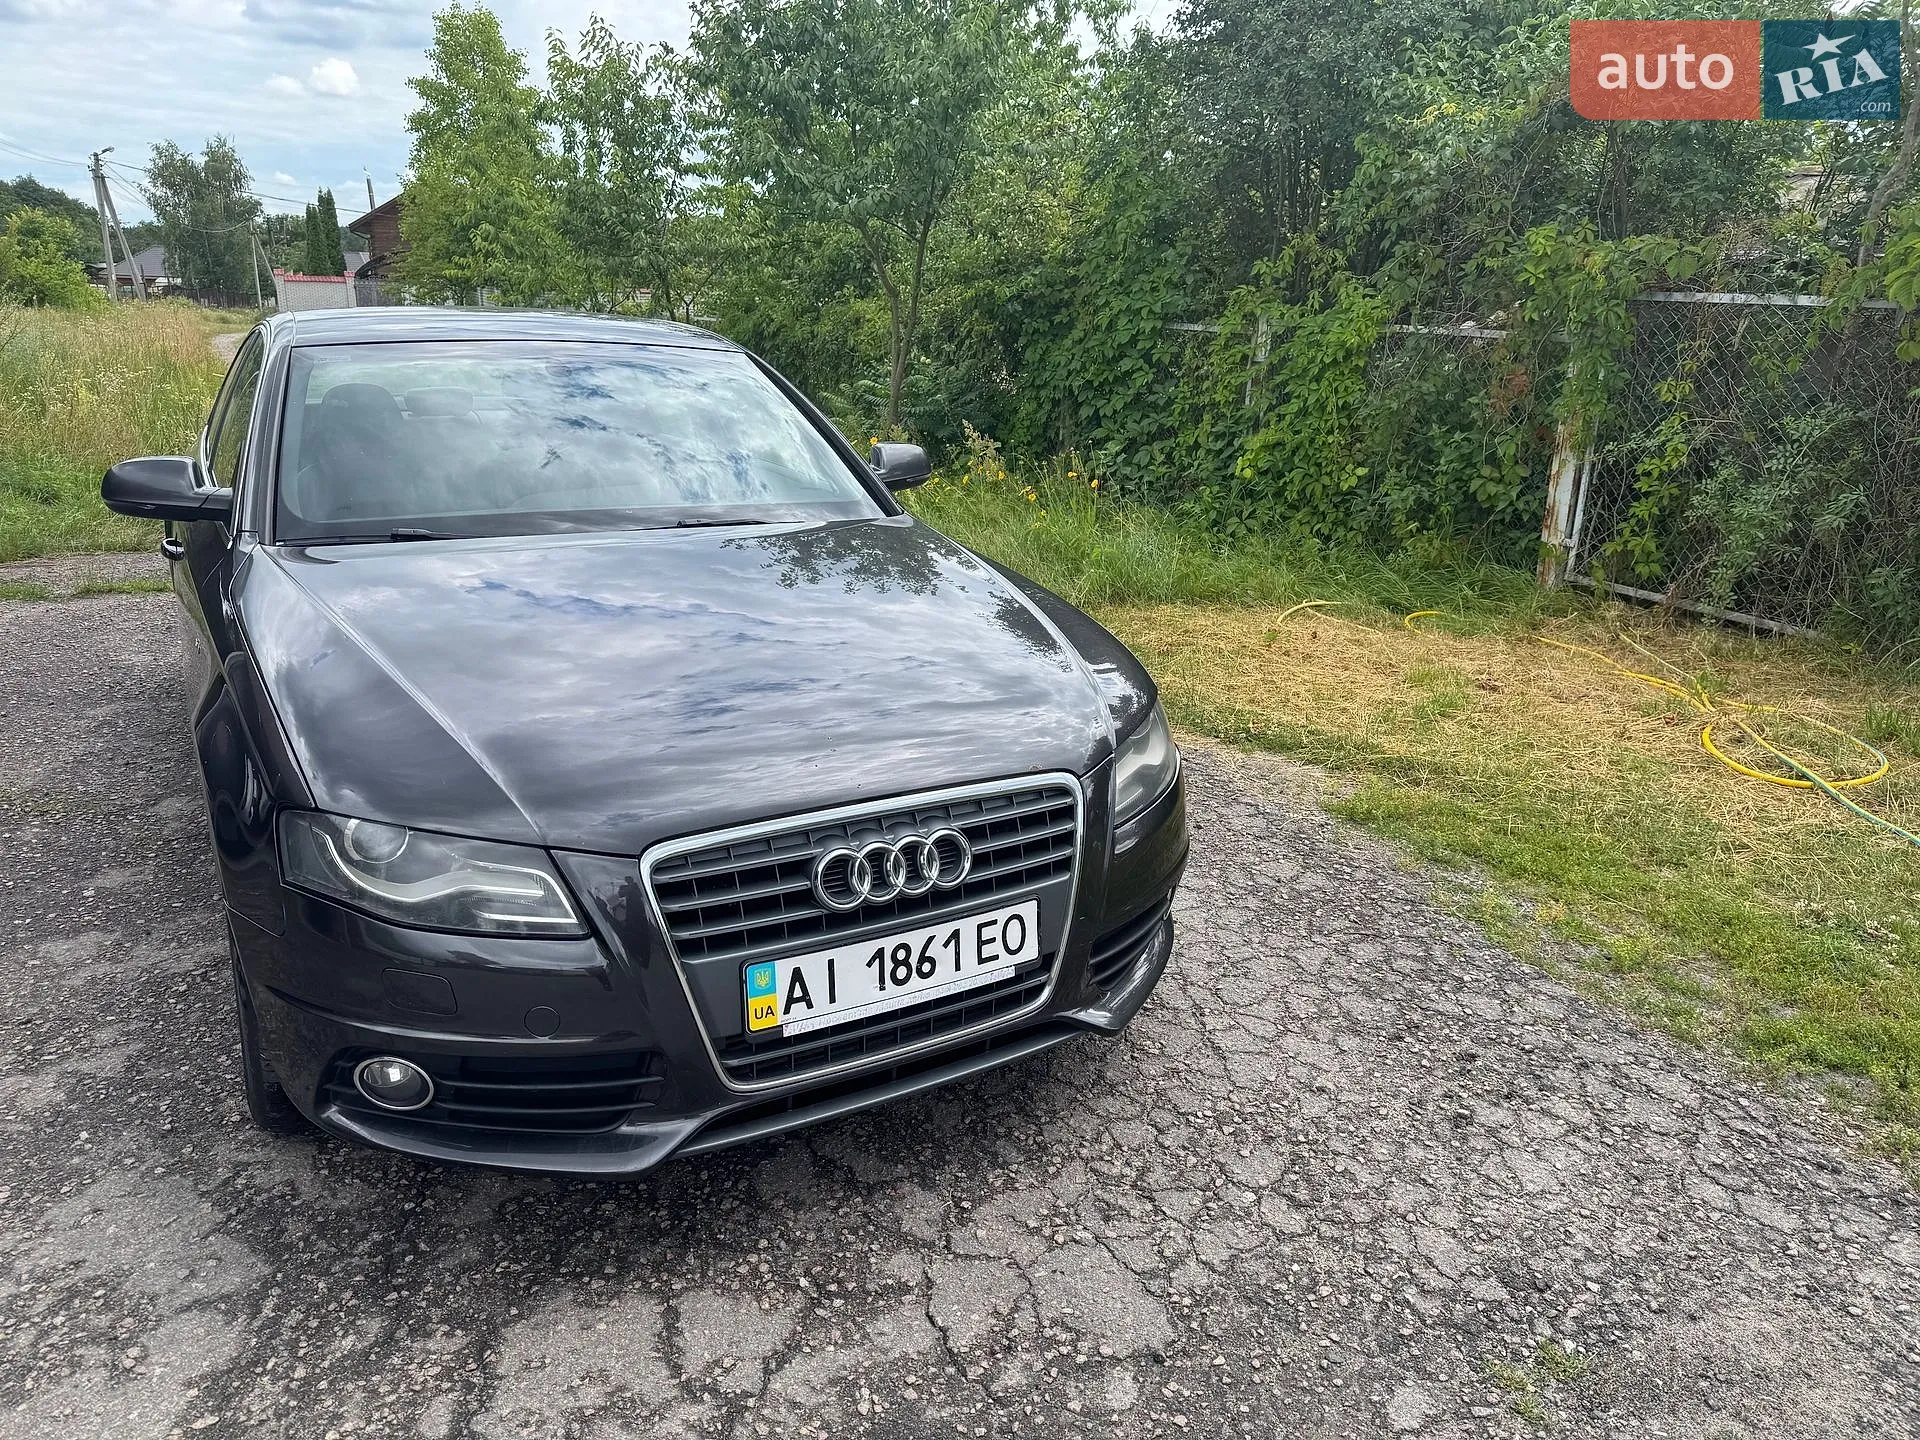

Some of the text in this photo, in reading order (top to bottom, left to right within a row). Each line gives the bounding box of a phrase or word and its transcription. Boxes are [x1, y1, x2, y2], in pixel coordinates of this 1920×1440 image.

[783, 958, 836, 1016] AI
[865, 928, 961, 991] 1861
[976, 913, 1026, 965] EO
[754, 1005, 775, 1020] UA
